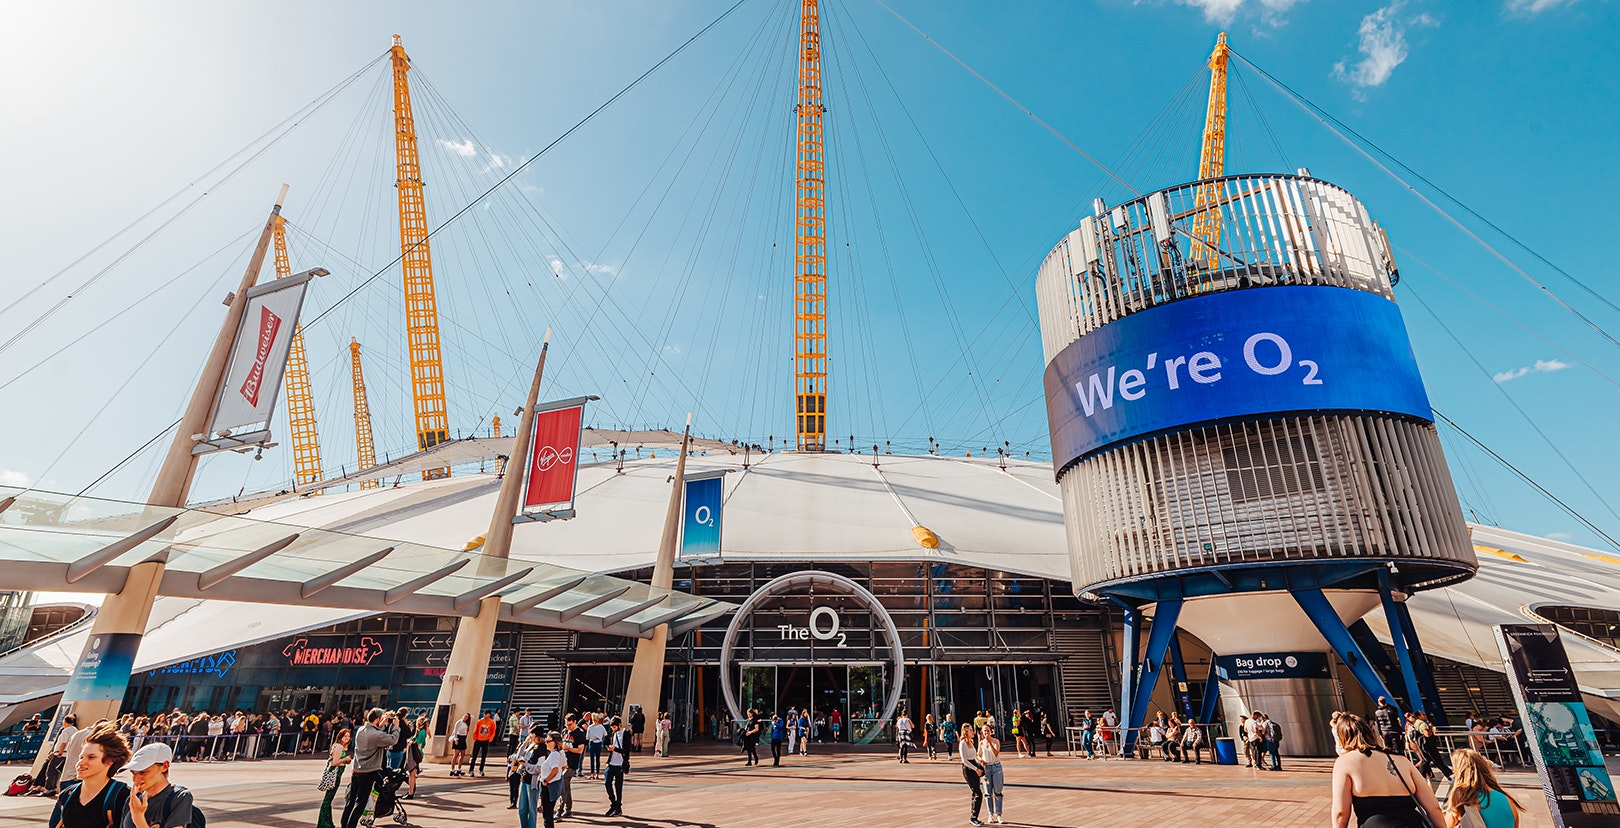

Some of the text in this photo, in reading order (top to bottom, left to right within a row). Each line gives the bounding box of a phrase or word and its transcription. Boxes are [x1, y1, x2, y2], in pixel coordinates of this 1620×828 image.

[244, 313, 275, 399] Budweiser
[695, 505, 714, 527] O2
[777, 624, 809, 640] The
[294, 647, 369, 665] MERCHANDISE
[1236, 656, 1281, 669] Bag drop
